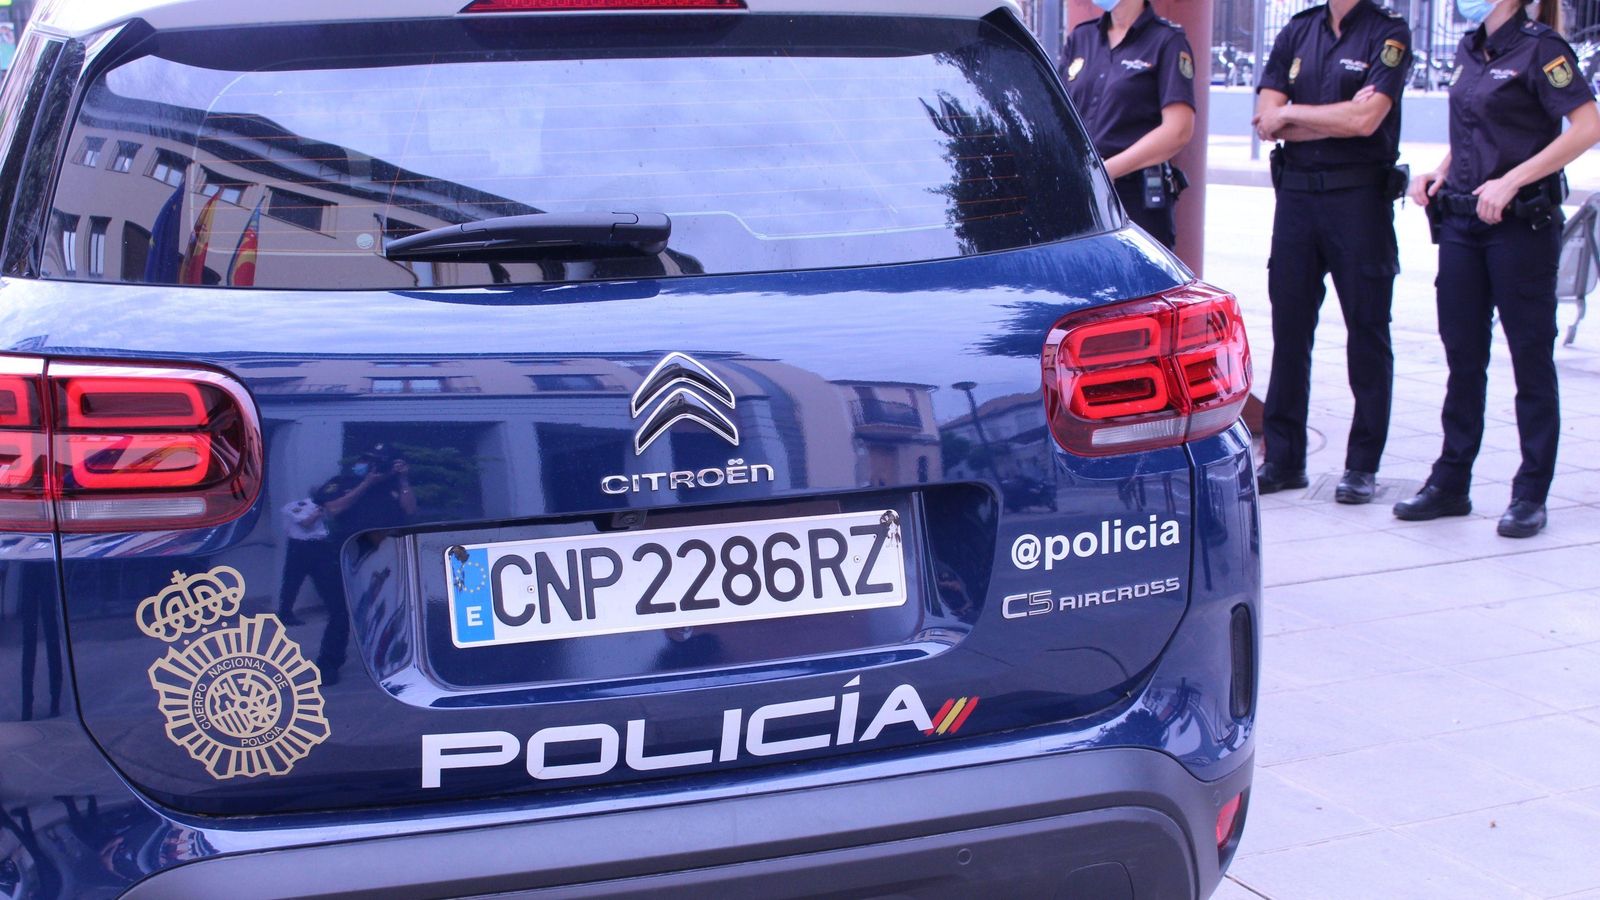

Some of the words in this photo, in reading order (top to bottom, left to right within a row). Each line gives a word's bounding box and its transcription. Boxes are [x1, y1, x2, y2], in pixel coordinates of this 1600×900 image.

[1011, 513, 1180, 571] @policia
[466, 605, 484, 627] E
[1002, 589, 1054, 619] C5
[1059, 577, 1181, 611] AIRCROSS
[193, 683, 212, 730] CUERPO
[208, 658, 268, 678] NACIONAL
[272, 673, 289, 690] DE
[240, 725, 284, 747] POLICIA
[421, 674, 935, 790] POLICÍA
